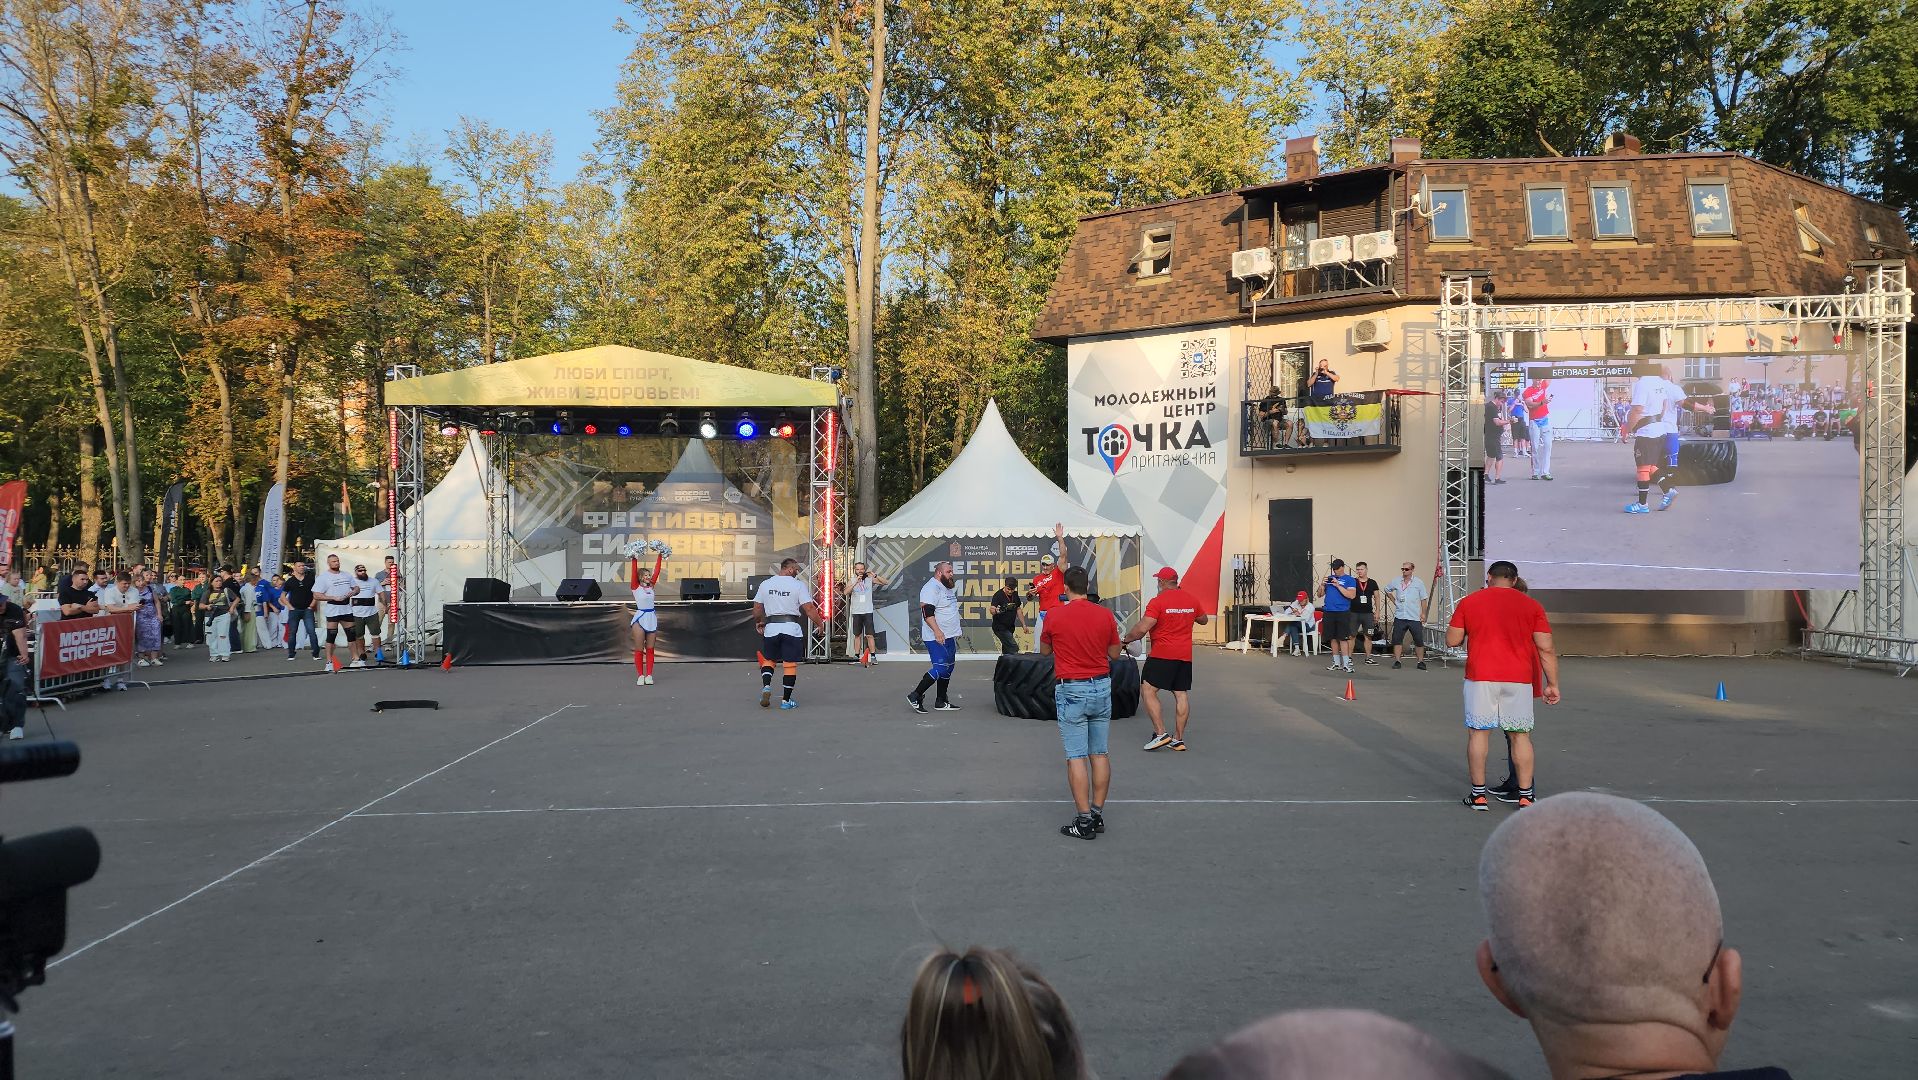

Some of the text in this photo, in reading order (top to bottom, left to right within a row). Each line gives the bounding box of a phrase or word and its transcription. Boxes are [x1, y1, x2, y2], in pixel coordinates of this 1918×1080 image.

[554, 367, 673, 382] ЛЮБИ СПОРТ,
[1552, 366, 1633, 377] БЕГОВАЯ ЭСТАФЕТА
[526, 386, 700, 400] ЖИВИ ЗДОРОВЬЕМ!
[1094, 382, 1216, 407] МОЛОДЕЖНЫЙ
[1163, 402, 1216, 418] ЦЕНТР
[1081, 420, 1212, 475] ТОЧКА
[582, 511, 757, 528] ФЕСТИВАЛЬ
[59, 626, 116, 648] МОСОБЛ
[59, 641, 105, 662] СПОРТ
